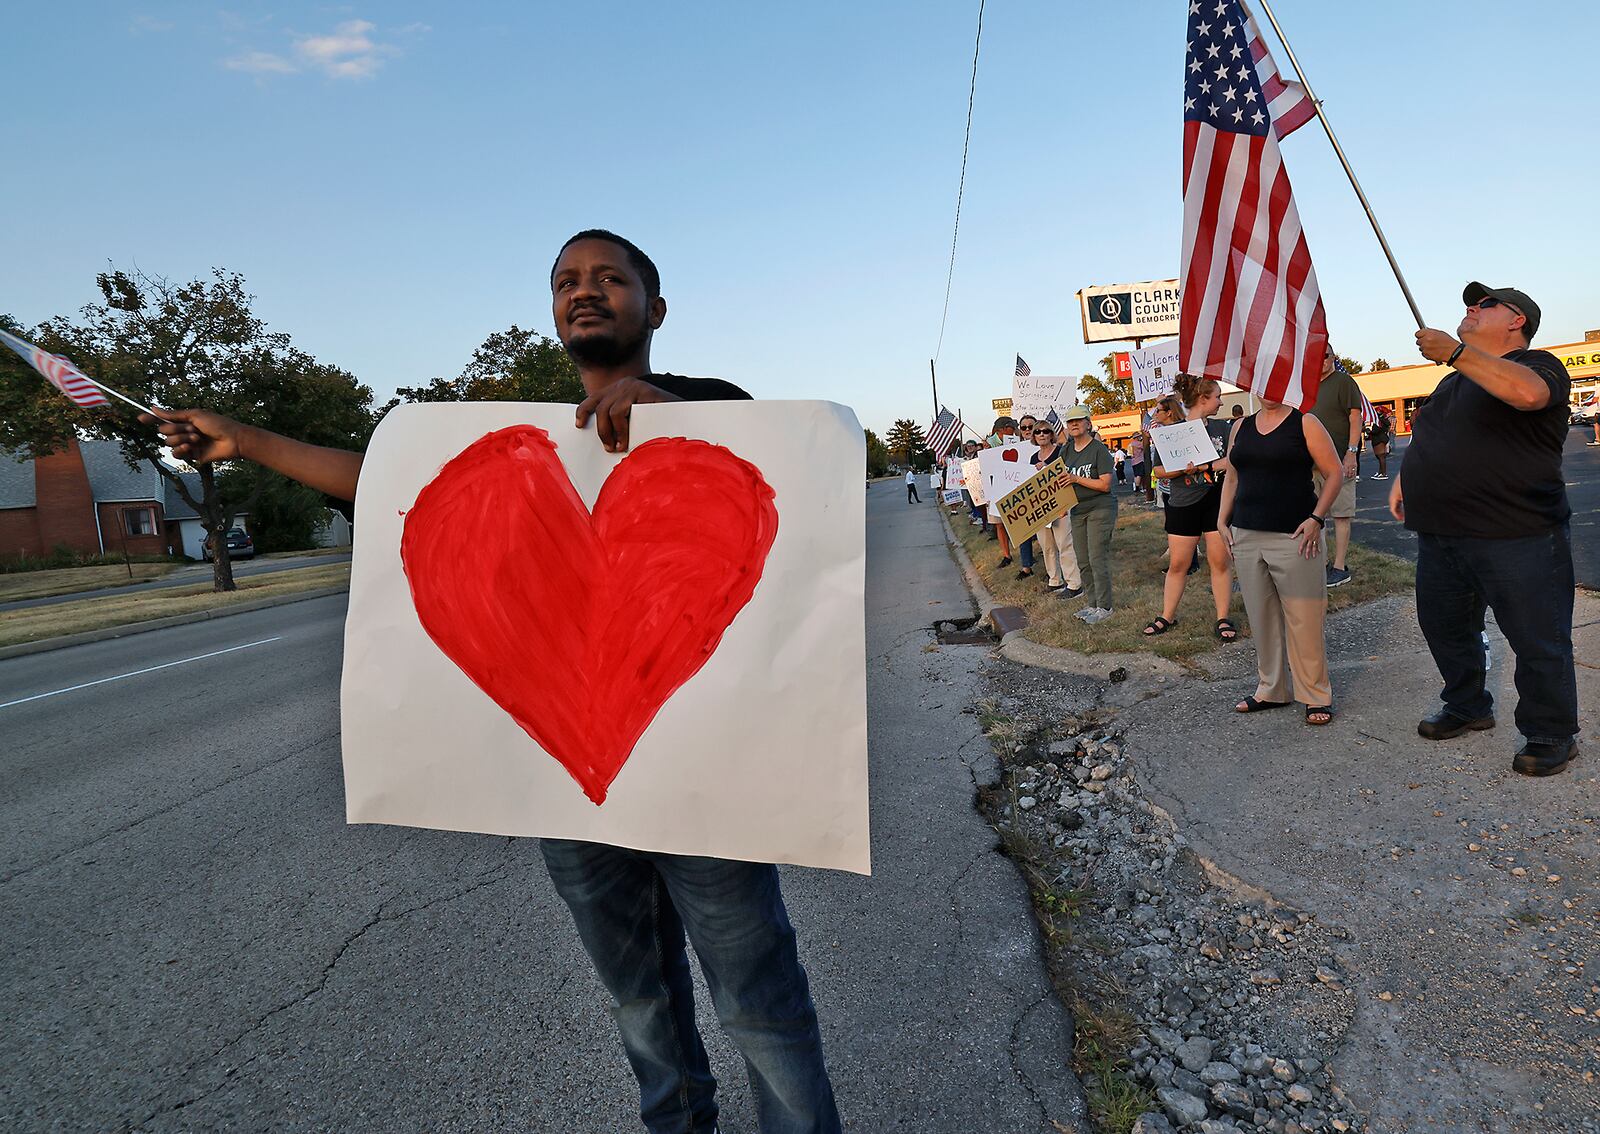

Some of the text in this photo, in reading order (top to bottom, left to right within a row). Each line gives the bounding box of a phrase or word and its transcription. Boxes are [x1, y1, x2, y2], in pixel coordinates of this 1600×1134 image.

[1134, 289, 1180, 303] CLARK
[1135, 302, 1180, 315] COUNT
[1017, 380, 1055, 389] We Love
[1160, 427, 1196, 444] CHOOSE
[1004, 470, 1019, 482] WE
[1000, 462, 1064, 513] HATE HAS
[1007, 481, 1062, 525] NO HOM
[1025, 497, 1059, 526] HERE
